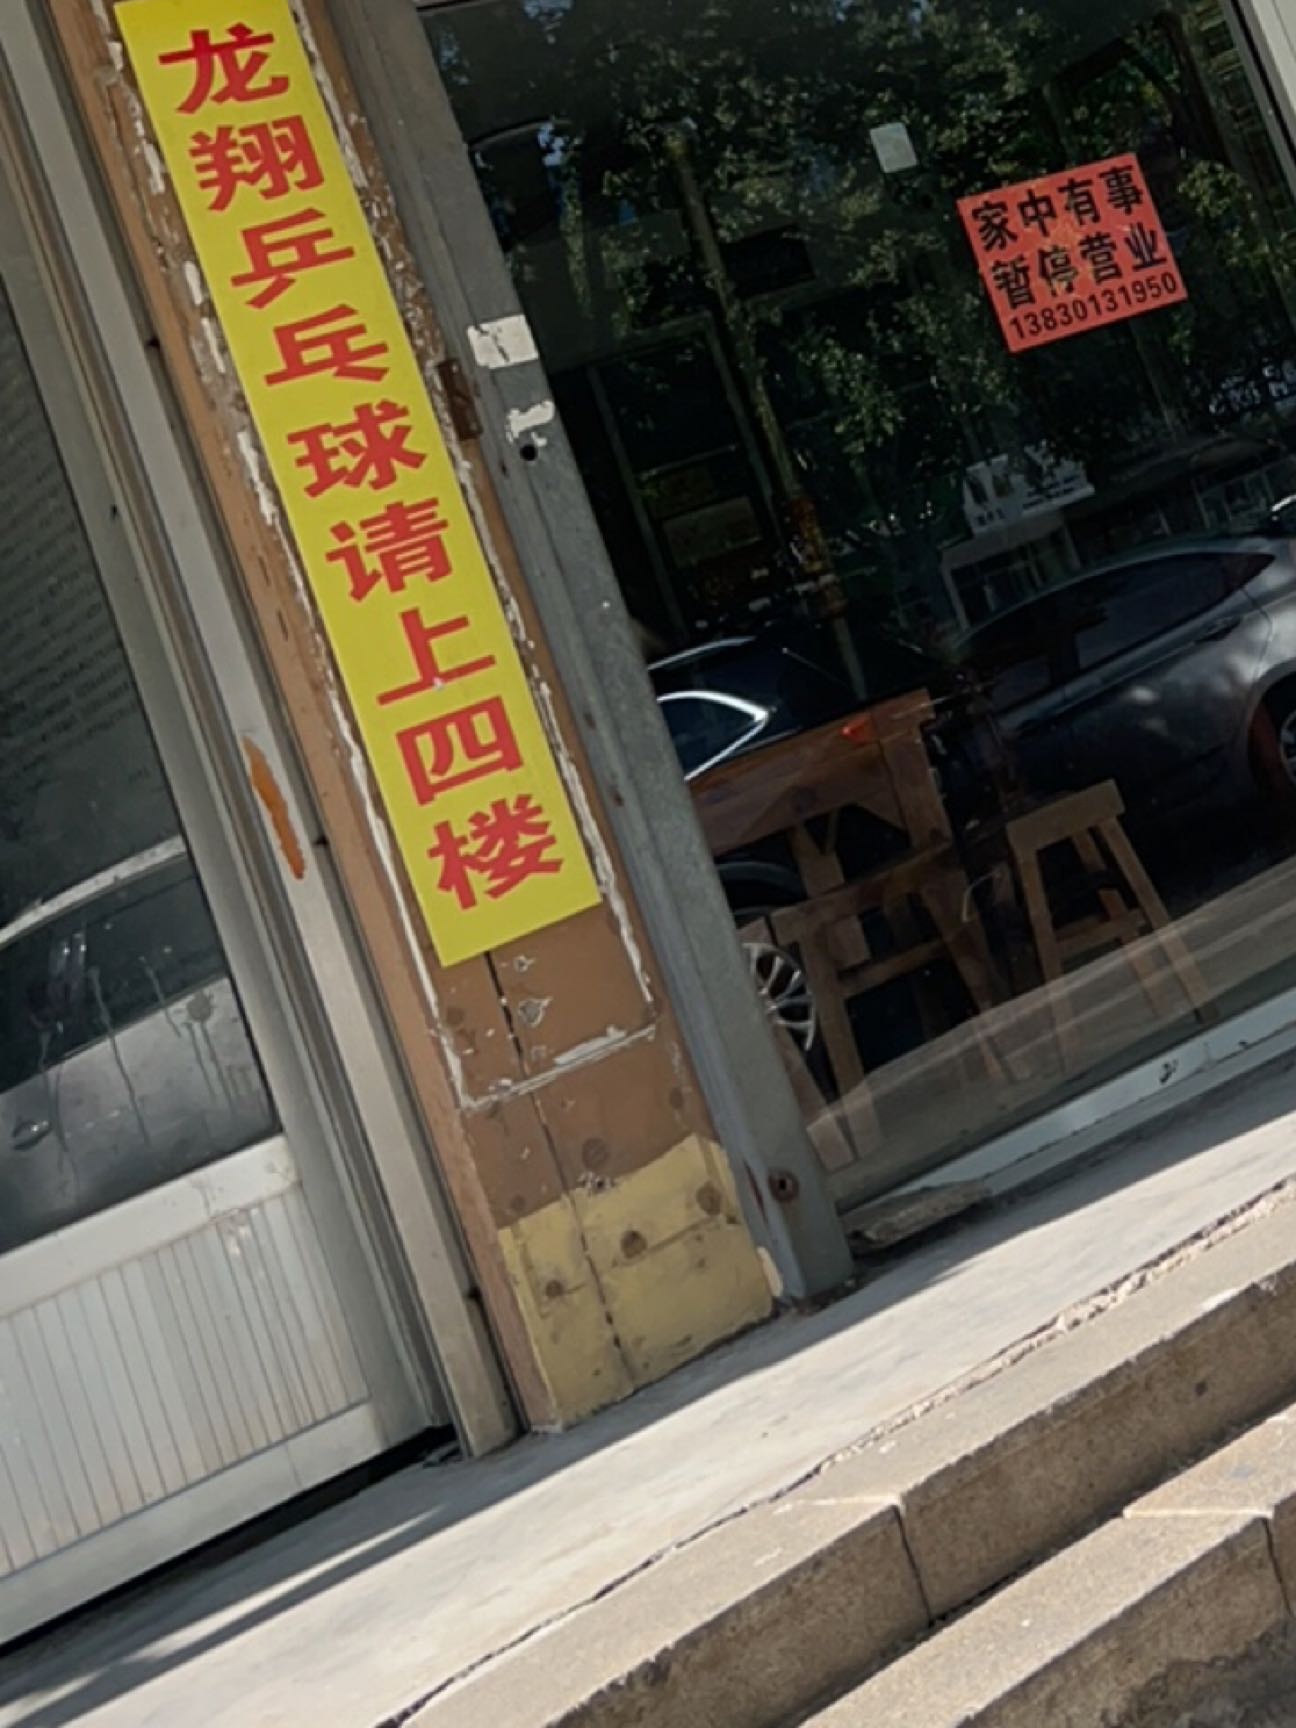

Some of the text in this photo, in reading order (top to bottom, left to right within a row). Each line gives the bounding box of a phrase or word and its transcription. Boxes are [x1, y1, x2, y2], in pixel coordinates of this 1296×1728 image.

[972, 163, 1144, 252] 家中有事
[991, 223, 1167, 310] 暂停营业
[1009, 272, 1178, 340] 13830131950
[158, 23, 565, 912] 龙翔乒乓球请上四楼
